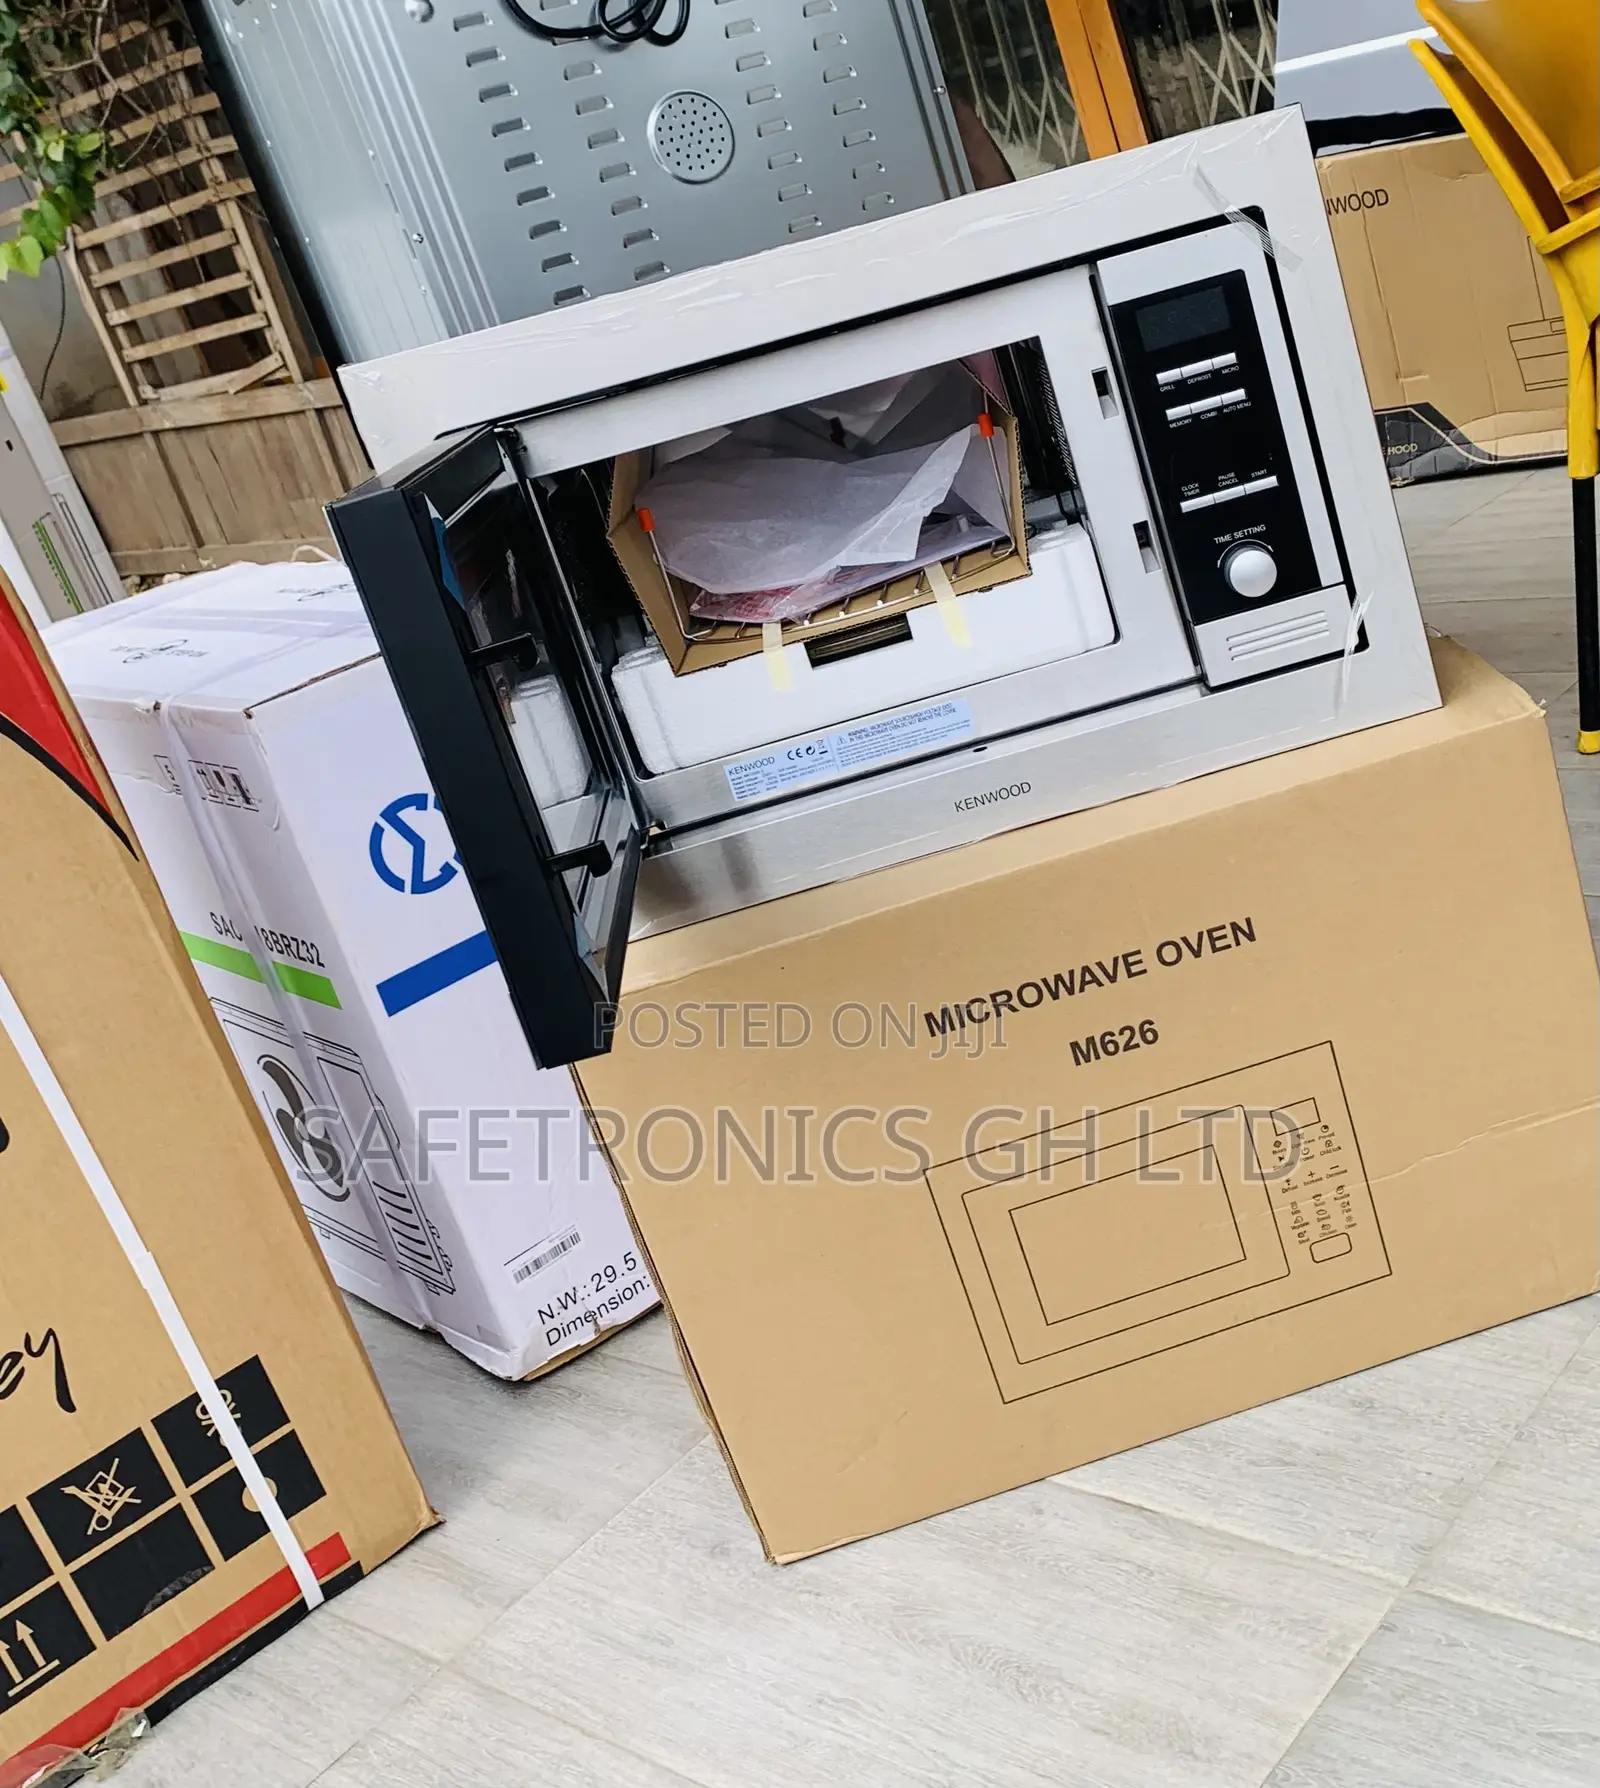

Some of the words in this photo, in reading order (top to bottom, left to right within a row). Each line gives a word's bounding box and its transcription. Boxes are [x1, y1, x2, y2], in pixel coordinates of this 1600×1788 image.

[1221, 365, 1240, 374] MICRO
[1187, 373, 1212, 385] DEFROST
[1160, 384, 1175, 392] GRILL
[1223, 405, 1236, 413] AUTO
[1236, 401, 1251, 410] MENU
[1169, 418, 1192, 428] MEMORY
[1388, 443, 1418, 455] HOOD
[1218, 472, 1235, 481] PAUSE
[1250, 469, 1267, 478] START
[1181, 482, 1199, 492] CLOCK
[1218, 478, 1239, 487] CANCEL
[1184, 488, 1200, 497] TIMER
[1214, 533, 1232, 544] TIME
[1233, 524, 1266, 539] SETTING
[728, 756, 775, 776] KENWOOD
[954, 781, 1032, 813] KENWOOD
[923, 949, 1146, 1038] MICROWAVE
[1156, 916, 1257, 968] OVEN
[1068, 1019, 1160, 1067] M626
[546, 1275, 650, 1346] Dimension:
